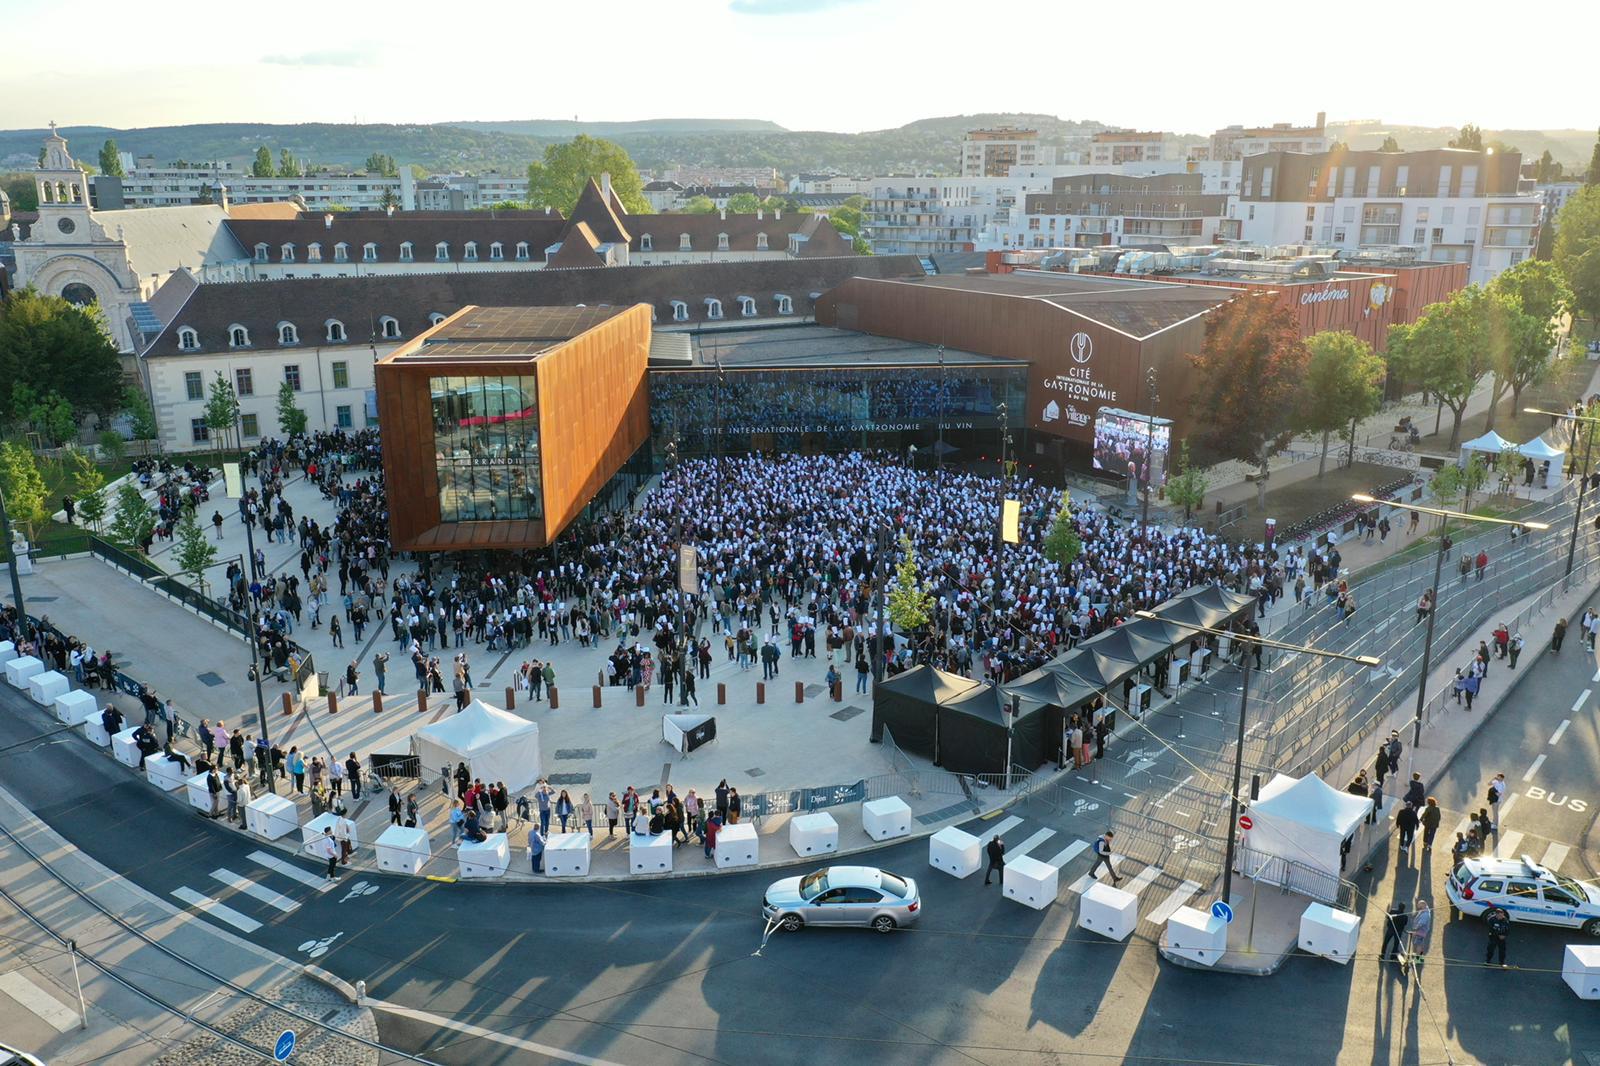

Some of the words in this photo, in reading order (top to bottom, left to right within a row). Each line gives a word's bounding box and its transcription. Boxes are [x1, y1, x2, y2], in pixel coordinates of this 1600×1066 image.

[1301, 283, 1349, 305] cinéma
[1069, 367, 1090, 379] CITÉ
[1044, 378, 1117, 401] GASTRONOMIE
[729, 425, 809, 434] INTERNATIONALE
[851, 423, 920, 431] GASTRONOMIE
[956, 422, 973, 430] VIN
[1525, 786, 1588, 812] BUS
